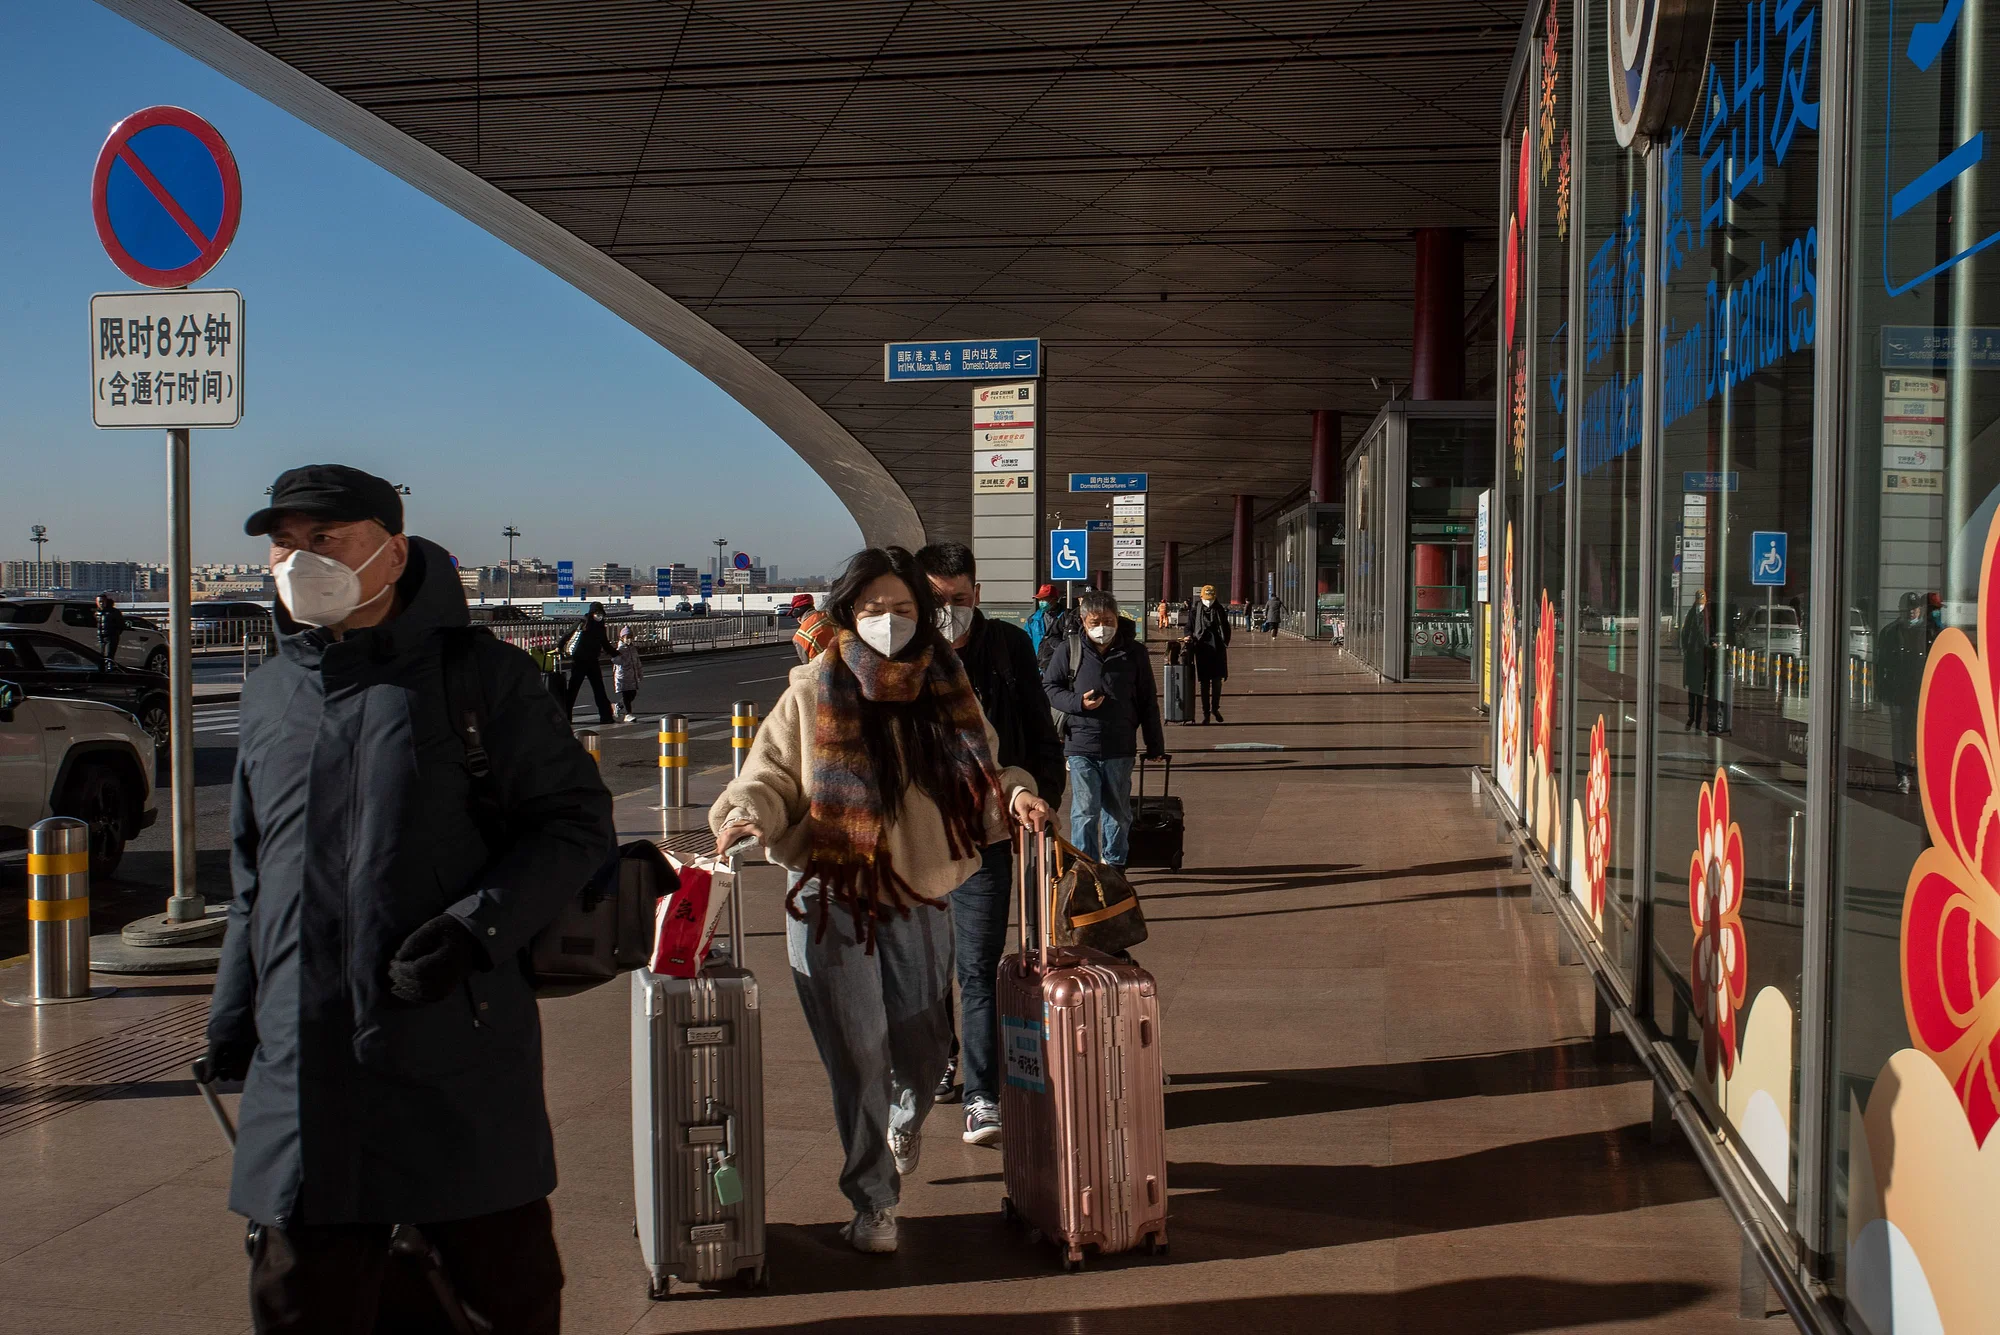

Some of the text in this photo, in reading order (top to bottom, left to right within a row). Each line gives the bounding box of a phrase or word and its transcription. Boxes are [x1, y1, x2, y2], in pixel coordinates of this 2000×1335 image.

[1706, 227, 1817, 421] Departures
[100, 313, 231, 360] 限时8分钟
[962, 348, 998, 360] 国内出发
[917, 363, 934, 372] Macao,
[935, 362, 951, 371] Taiwan
[962, 360, 1011, 371] Domestic Departures
